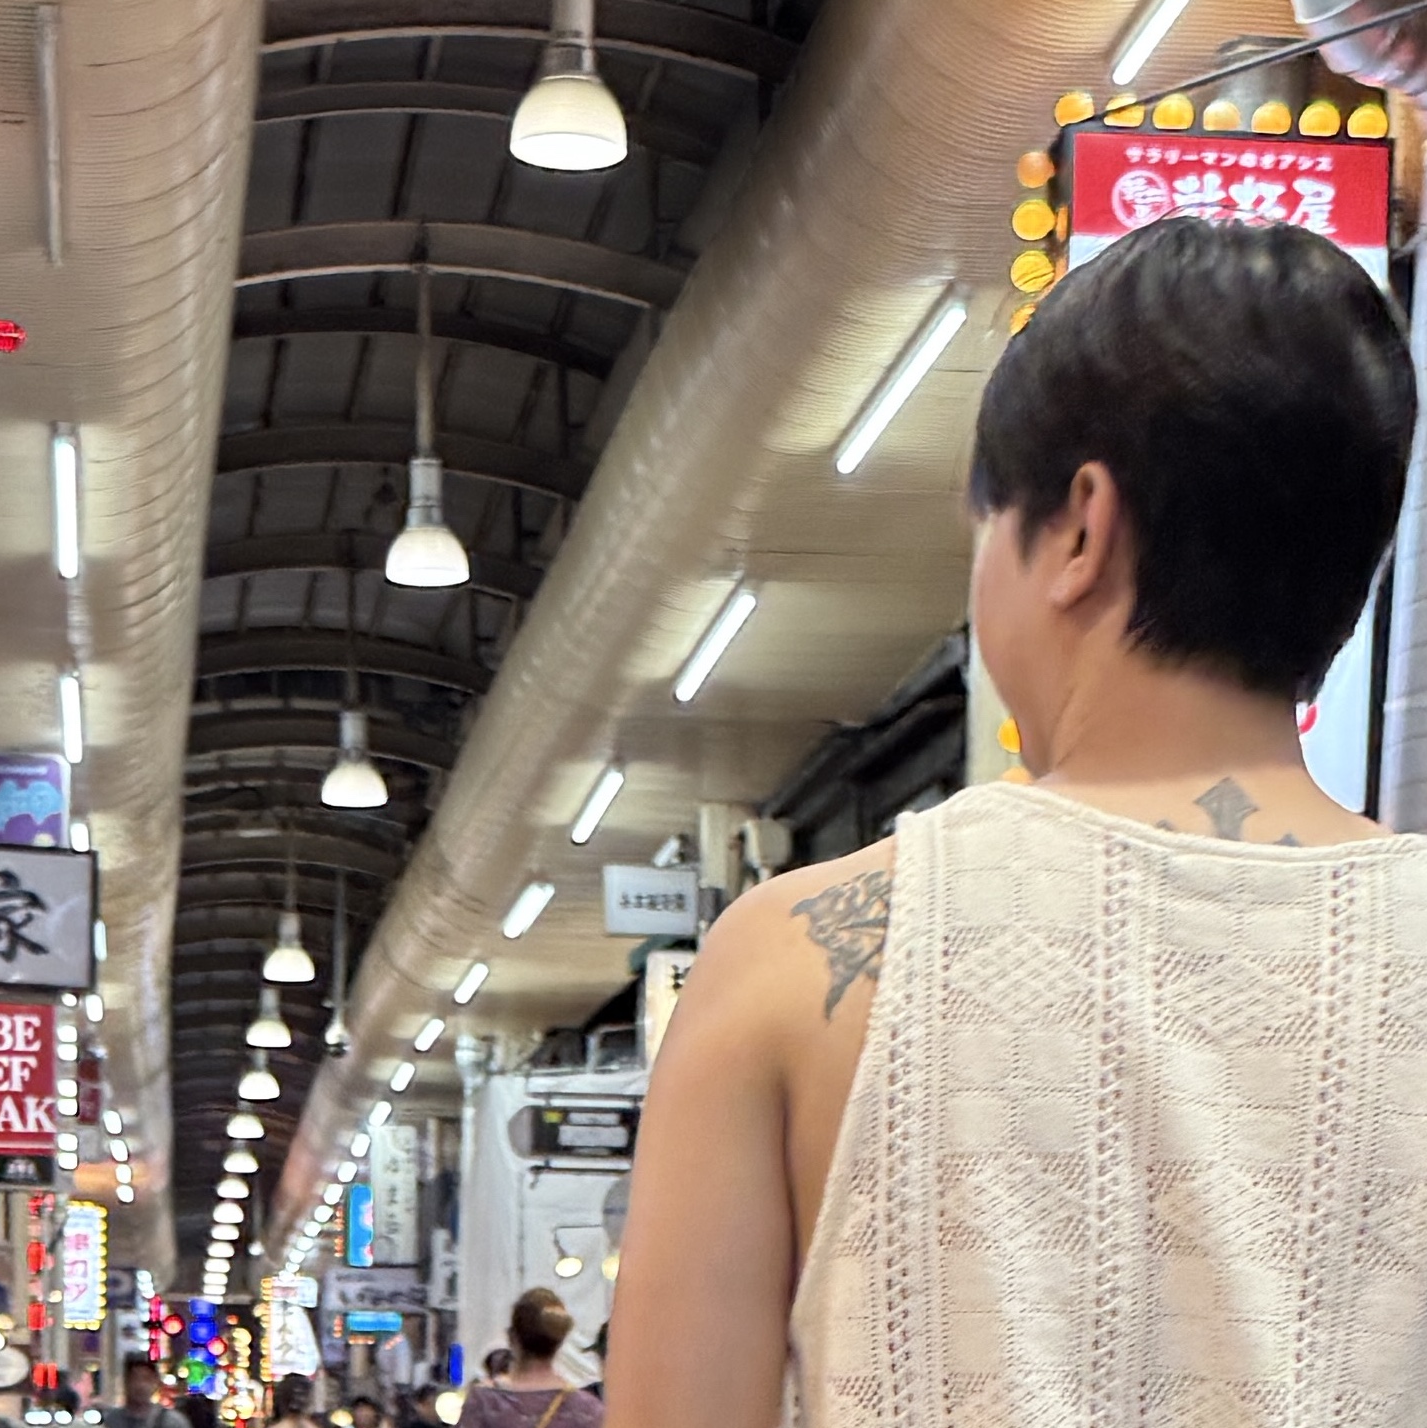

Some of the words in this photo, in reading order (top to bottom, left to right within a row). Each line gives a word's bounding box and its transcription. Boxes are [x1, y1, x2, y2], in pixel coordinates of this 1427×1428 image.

[1124, 146, 1334, 172] サラリーマンのオアシス
